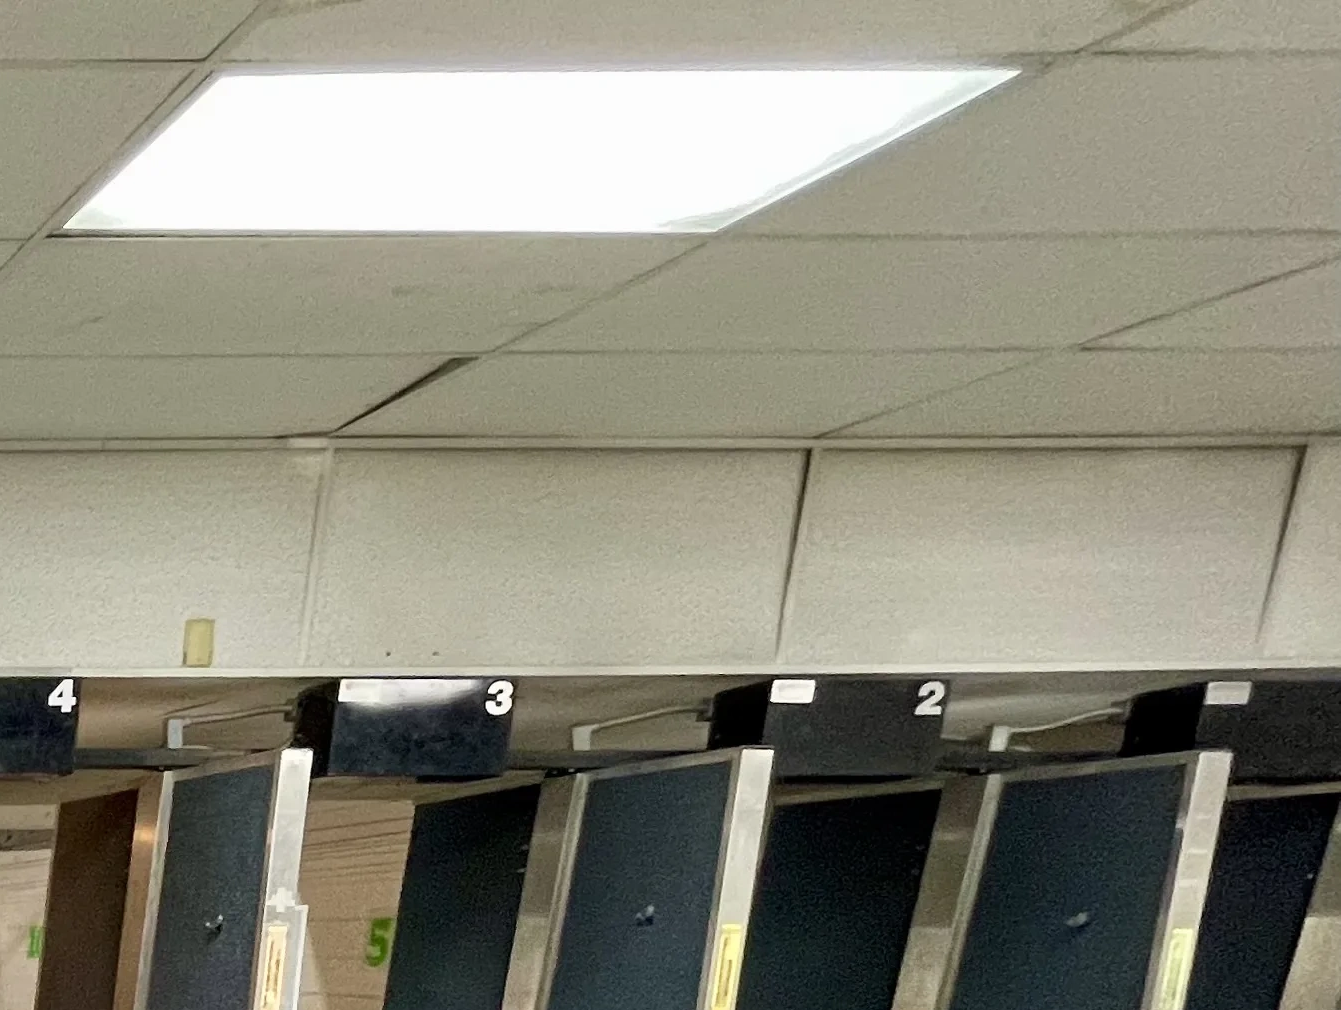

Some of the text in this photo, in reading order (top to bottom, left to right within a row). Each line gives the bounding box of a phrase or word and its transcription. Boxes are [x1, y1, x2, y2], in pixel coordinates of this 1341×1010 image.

[47, 678, 77, 713] 4
[485, 680, 515, 716] 3
[914, 680, 946, 716] 2
[364, 917, 393, 967] 5
